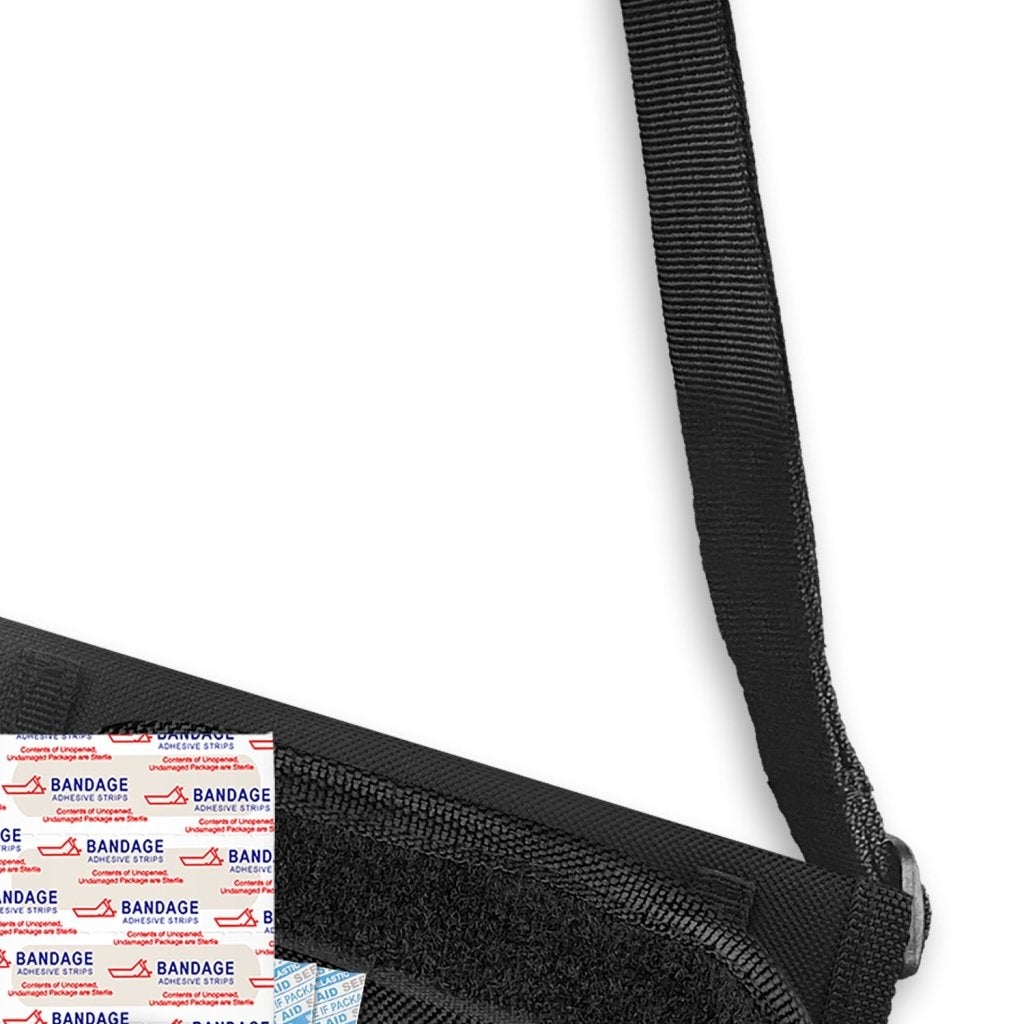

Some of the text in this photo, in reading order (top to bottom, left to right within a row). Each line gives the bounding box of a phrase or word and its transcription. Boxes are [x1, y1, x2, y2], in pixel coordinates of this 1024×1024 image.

[157, 742, 234, 750] ADHESIVE STRIPS
[51, 778, 128, 792] BANDAGE
[52, 794, 128, 802] ADHESIVE STRIPS
[193, 788, 271, 802] BANDAGE
[194, 804, 271, 812] ADHESIVE STRIPS
[87, 839, 164, 854] BANDAGE
[87, 856, 164, 864] ADHESIVE STRIPS
[228, 849, 274, 864] BAND
[229, 866, 272, 874] ADHESIVE
[26, 906, 58, 914] STRIPS
[121, 900, 199, 915] BANDAGE
[17, 920, 24, 928] of
[122, 917, 199, 925] ADHESIVE STRIPS
[16, 951, 94, 966] BANDAGE
[16, 968, 94, 976] ADHESIVE STRIPS
[157, 961, 234, 976] BANDAGE
[157, 978, 234, 986] ADHESIVE STRIPS
[317, 986, 338, 1002] AID
[281, 1004, 302, 1022] AID
